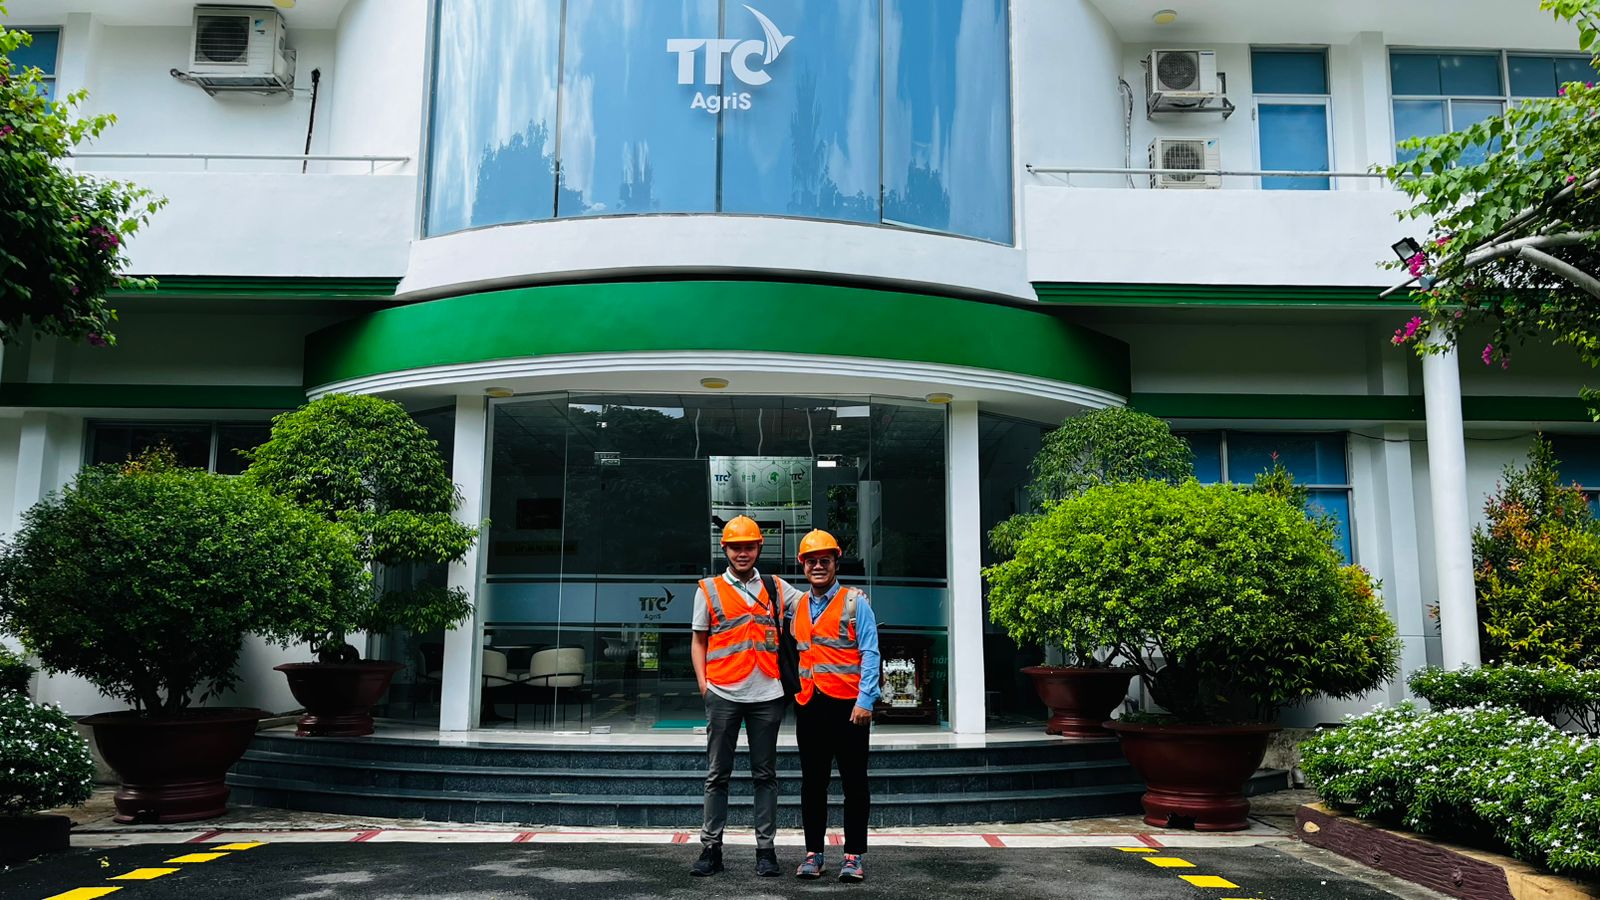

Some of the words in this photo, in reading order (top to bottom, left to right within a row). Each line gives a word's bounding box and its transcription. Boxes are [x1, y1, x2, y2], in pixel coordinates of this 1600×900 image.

[667, 38, 772, 85] TTC
[690, 92, 752, 113] AgriS
[714, 474, 729, 482] TTC
[639, 597, 667, 611] TTC
